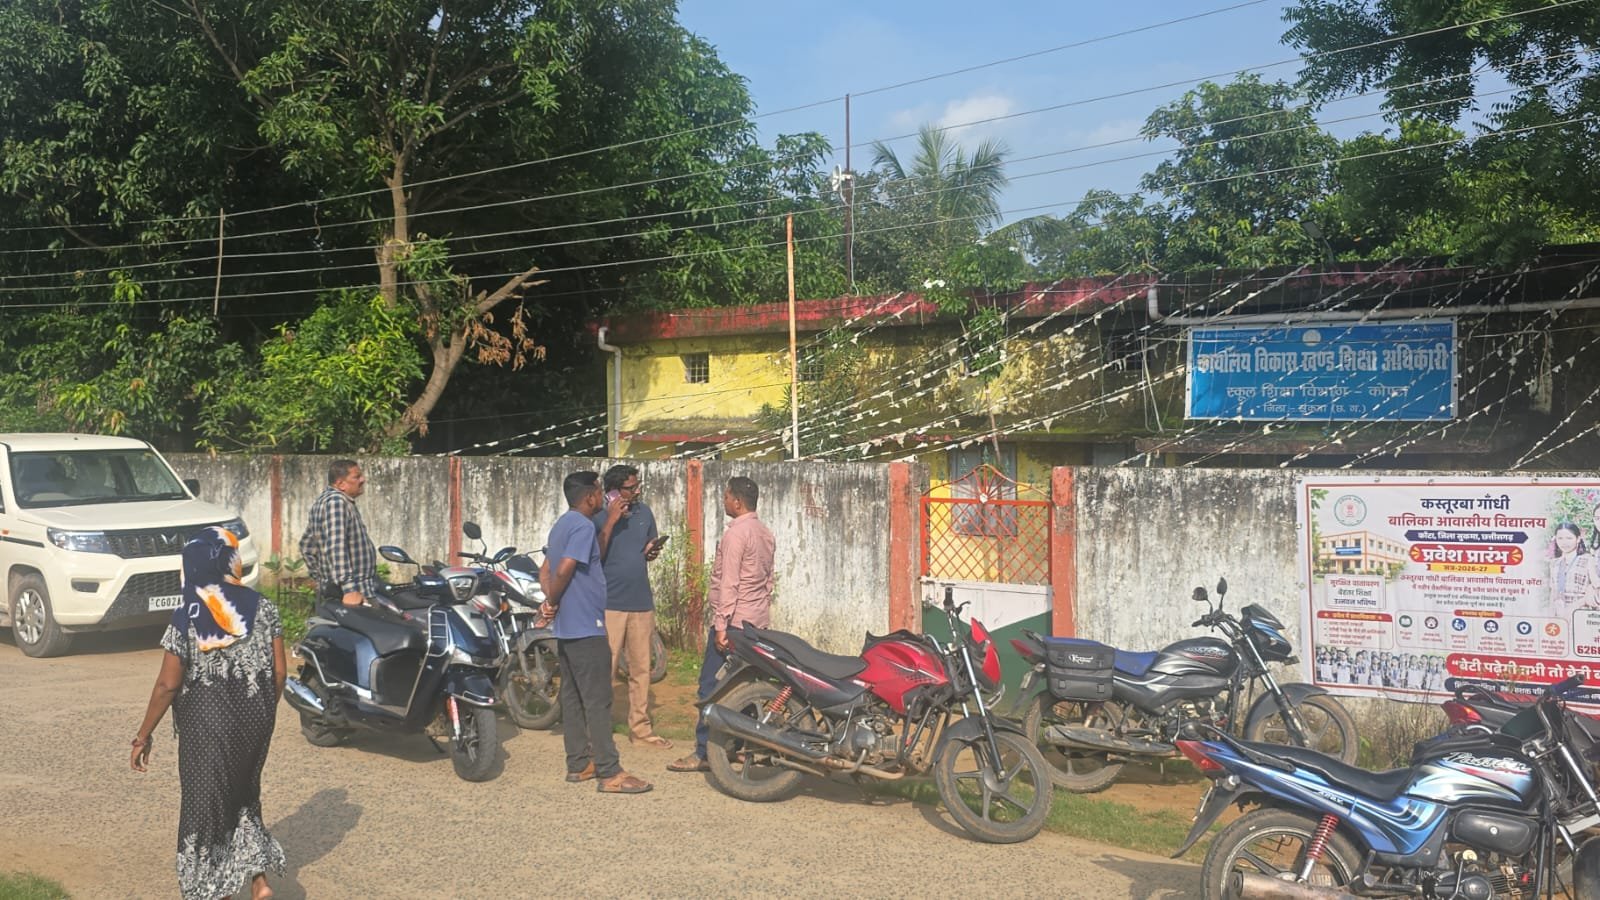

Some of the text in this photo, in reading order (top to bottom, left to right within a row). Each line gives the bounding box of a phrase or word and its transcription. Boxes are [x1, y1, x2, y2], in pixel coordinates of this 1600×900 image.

[1197, 343, 1448, 373] कार्यालय विकास खण्ड शिक्षा अधिकारी
[1227, 386, 1257, 402] स्कूल
[1264, 403, 1286, 412] जिला
[1420, 493, 1510, 514] कस्तूरबा गाँधी
[1388, 512, 1547, 529] बालिका आवासीय विद्यालय
[1437, 531, 1456, 540] जिला
[1421, 545, 1509, 563] प्रवेश प्रारंभ
[1483, 660, 1517, 675] पढ़ेगी
[1547, 664, 1564, 678] तो
